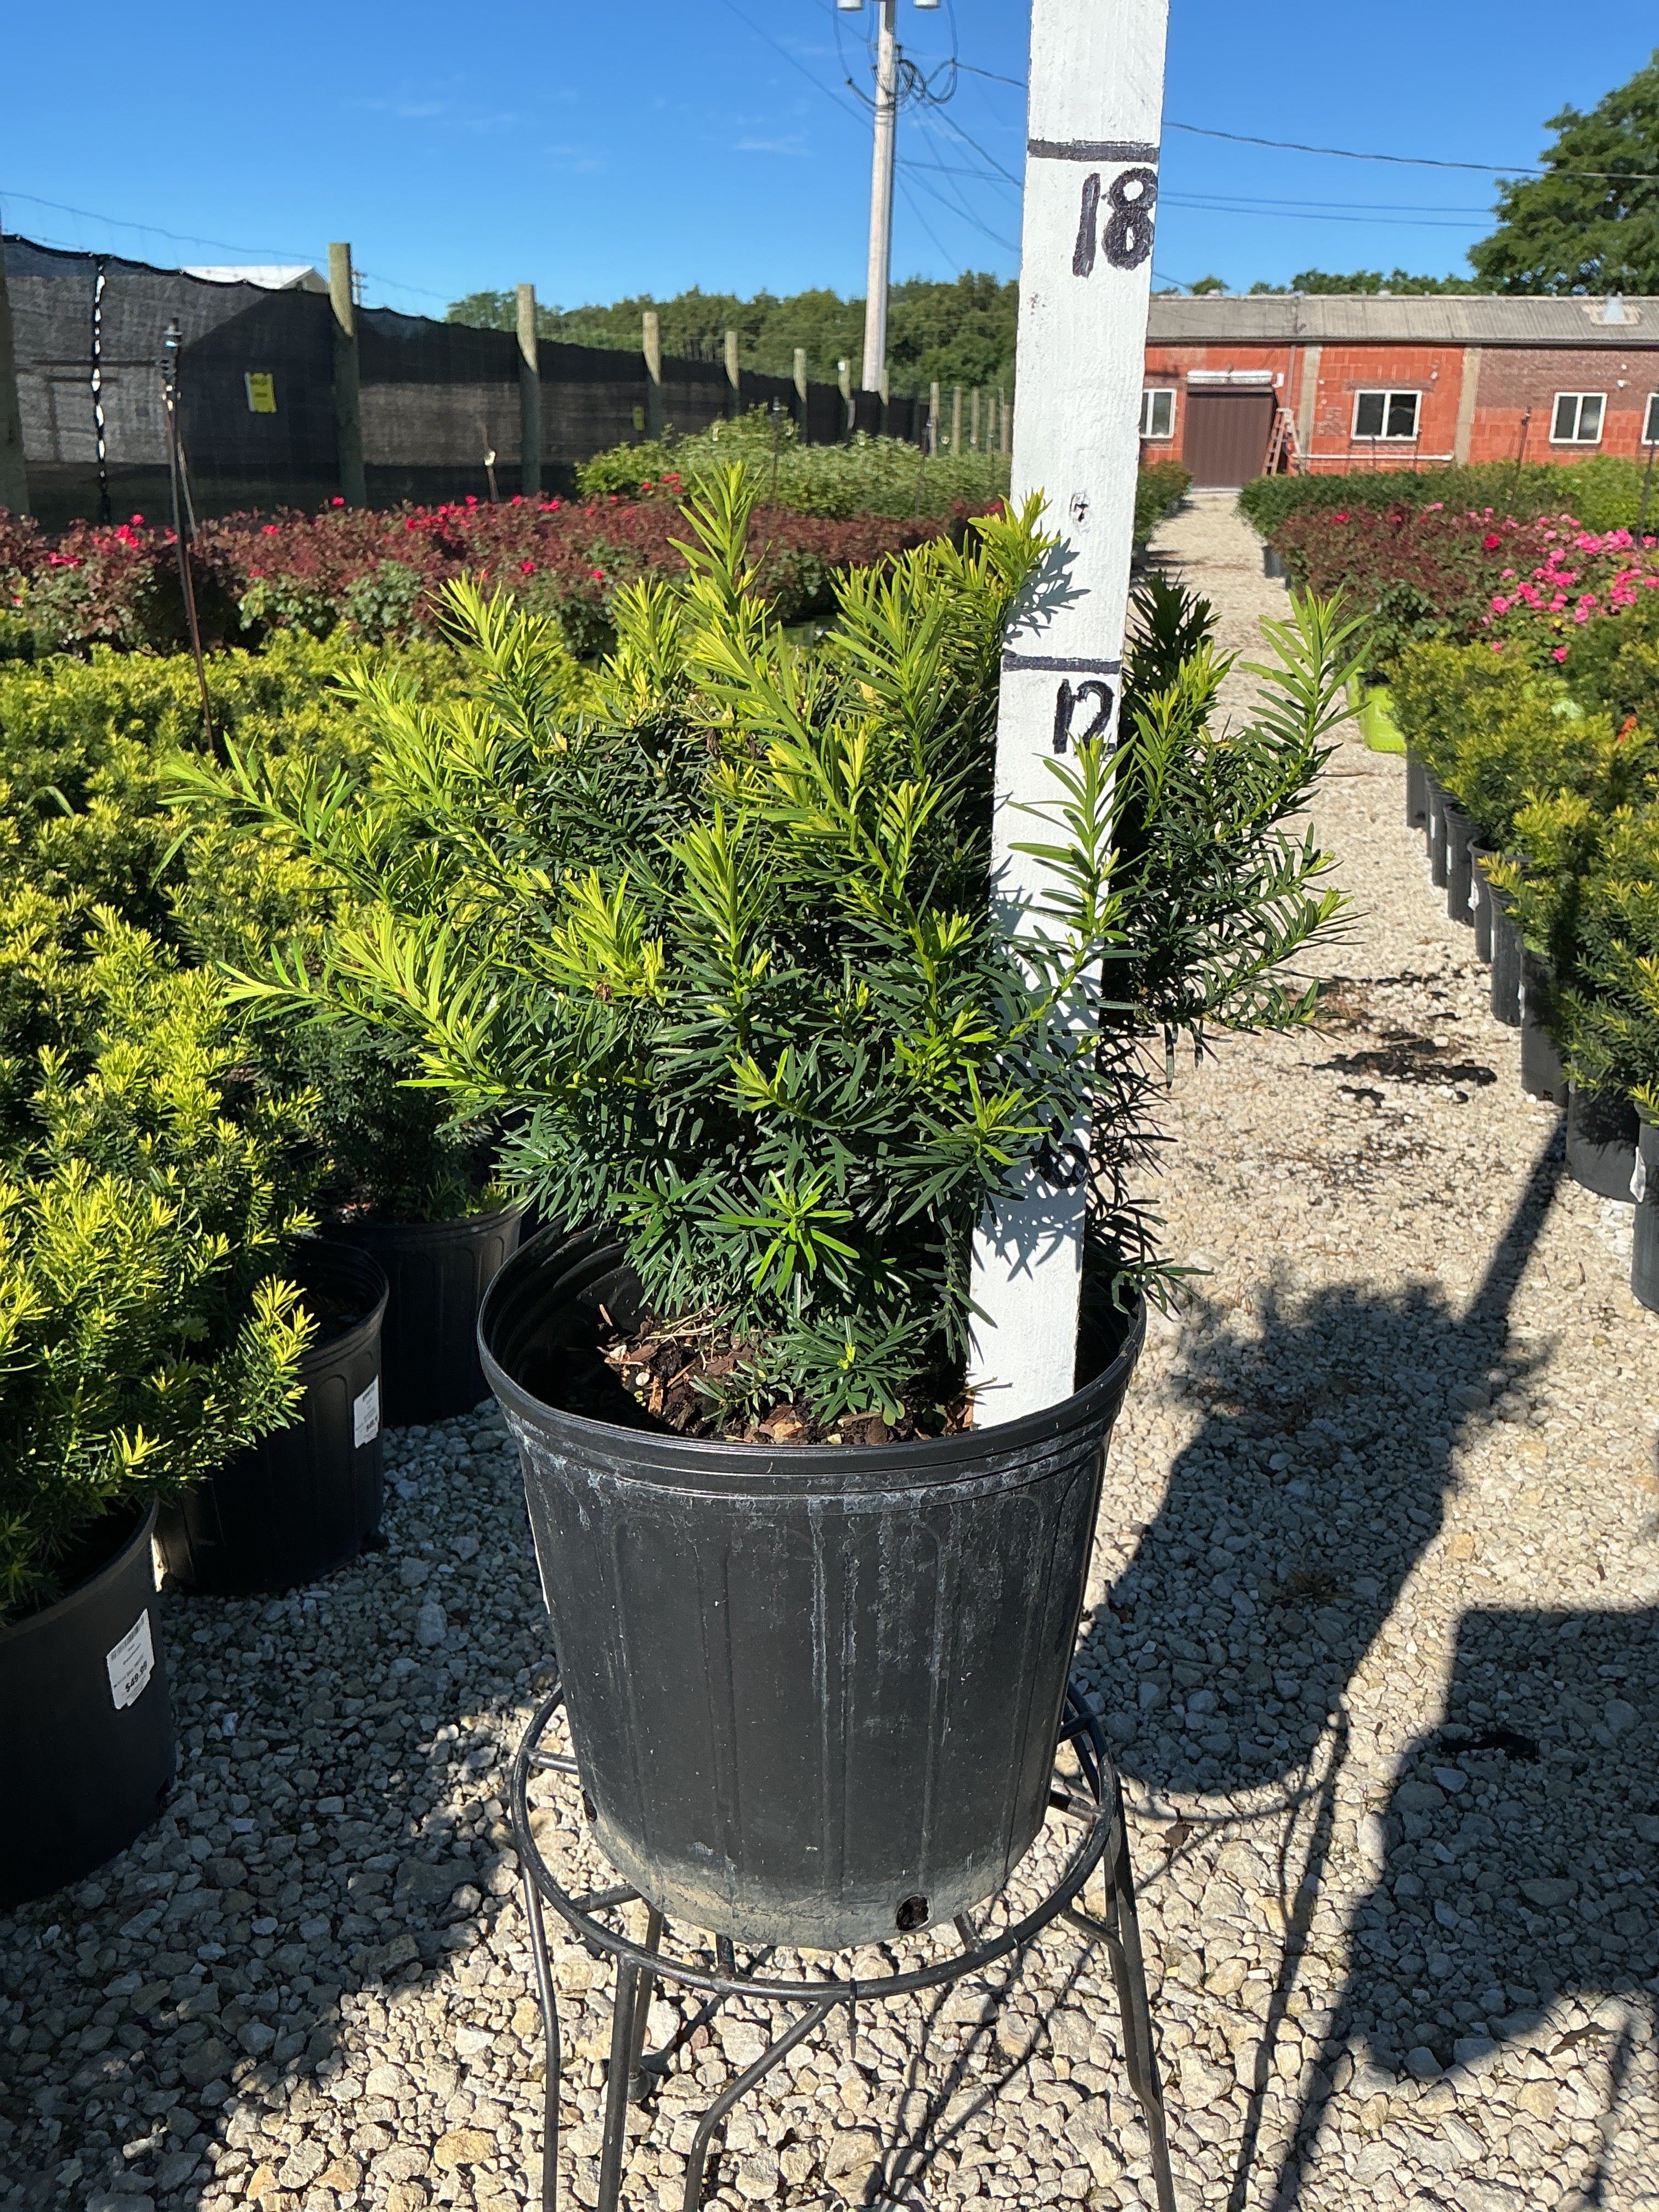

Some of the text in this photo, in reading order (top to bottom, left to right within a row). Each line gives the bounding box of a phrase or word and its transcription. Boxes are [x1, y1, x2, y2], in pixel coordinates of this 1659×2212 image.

[1073, 167, 1158, 278] 18
[1053, 679, 1117, 756] 12
[125, 1660, 148, 1692] $49.99
